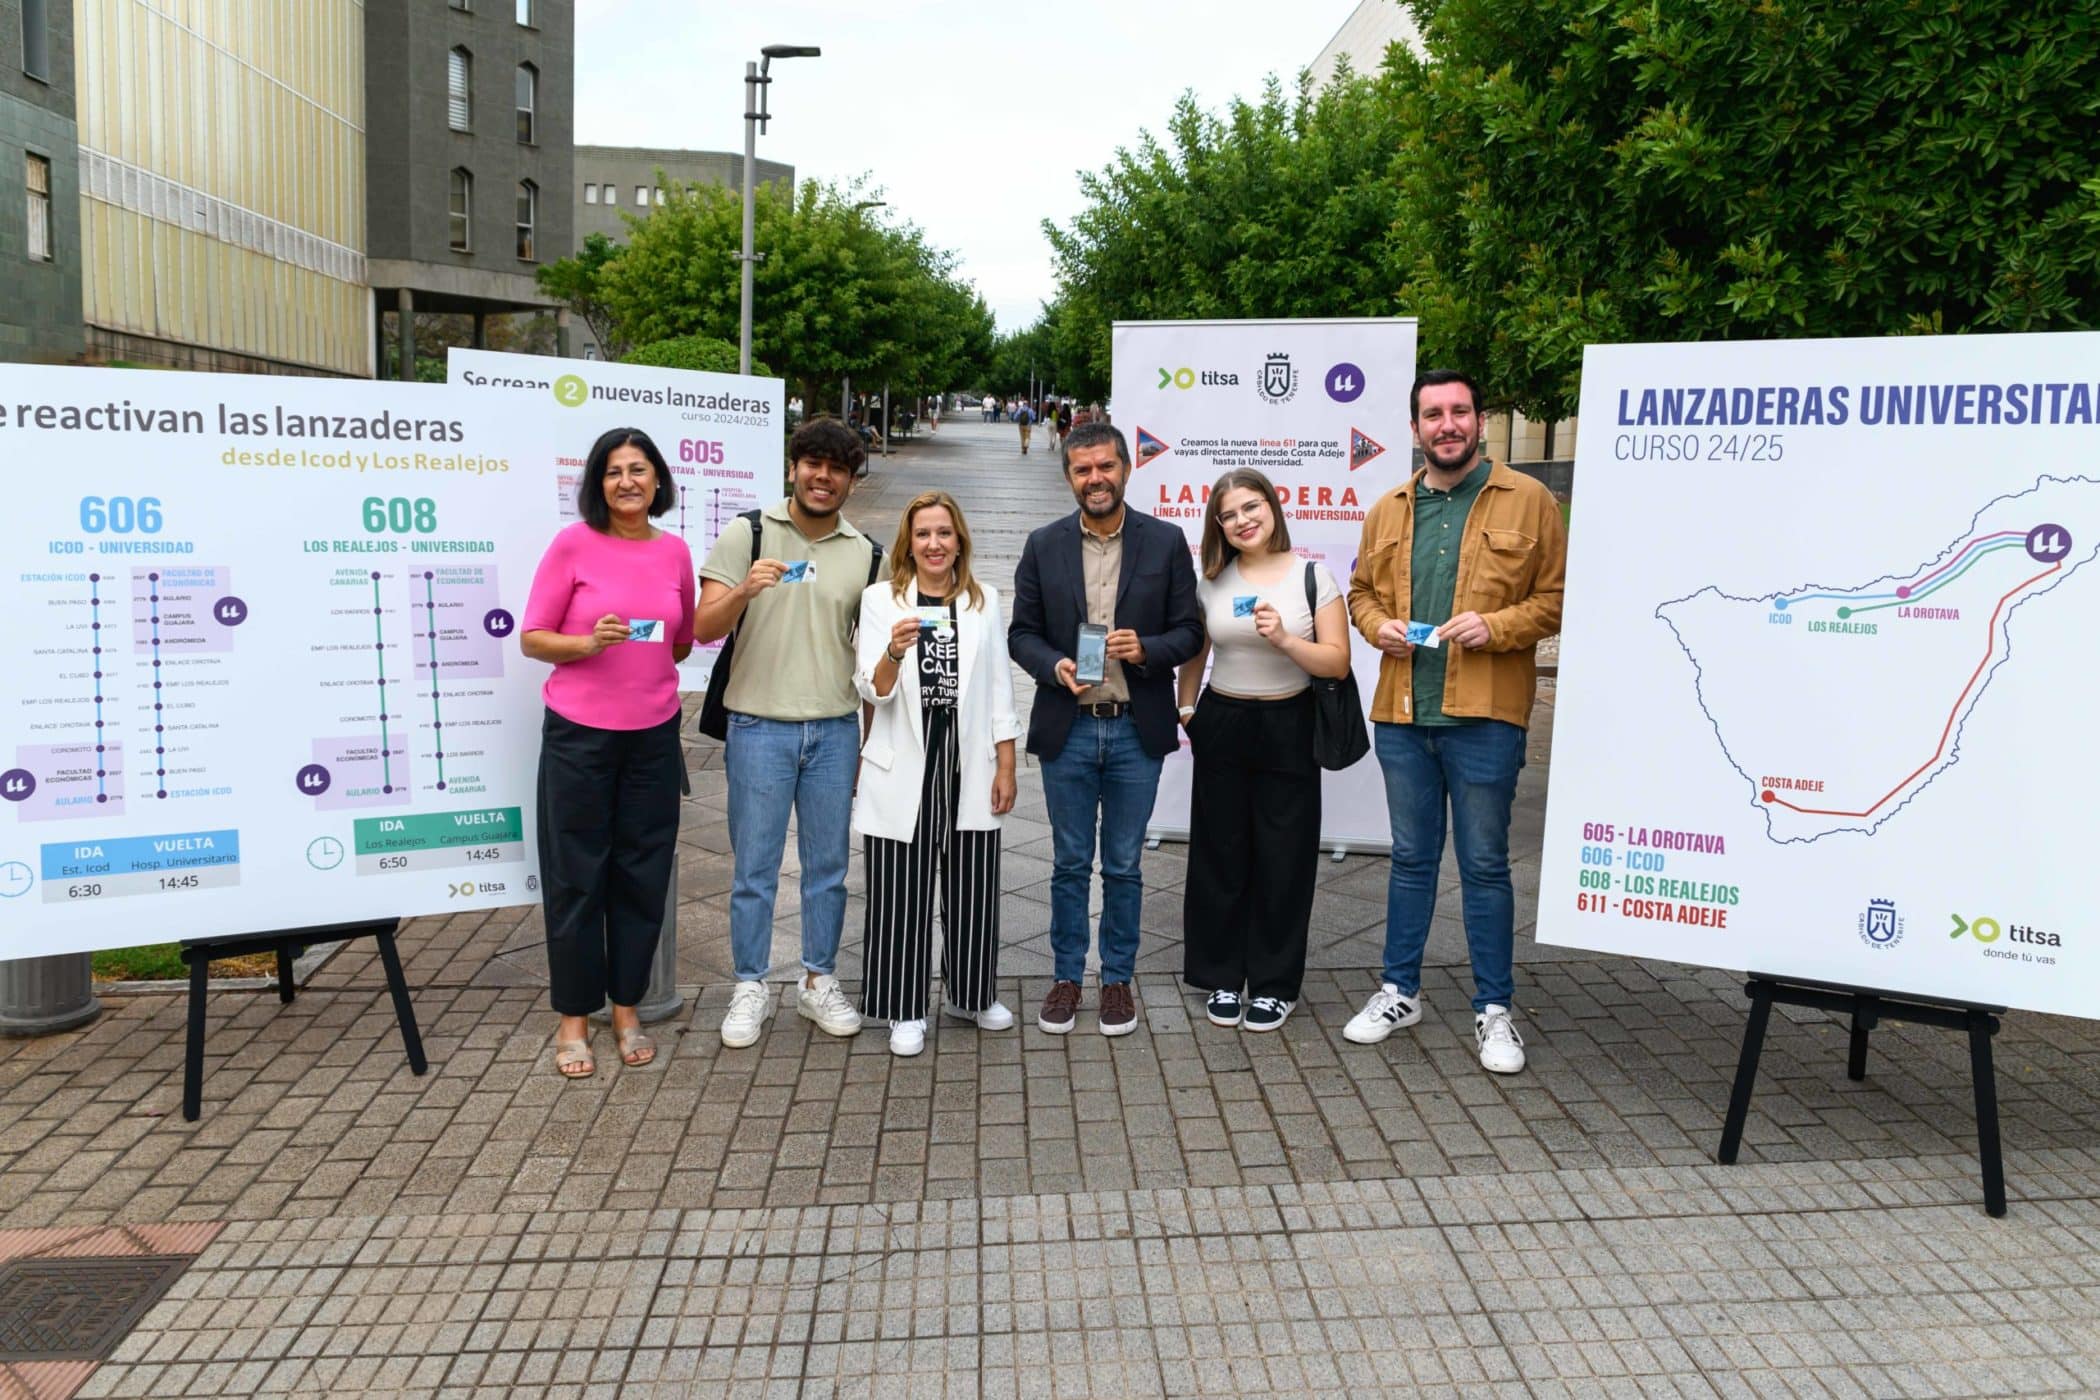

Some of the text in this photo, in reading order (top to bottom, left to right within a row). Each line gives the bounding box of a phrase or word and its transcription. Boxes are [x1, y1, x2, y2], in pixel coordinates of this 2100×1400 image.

[1201, 371, 1240, 386] titsa
[564, 382, 578, 401] 2
[592, 385, 663, 405] nuevas
[667, 386, 771, 414] lanzaderas
[1617, 383, 2100, 426] LANZADERAS UNIVERSITA
[17, 400, 204, 433] reactivan
[219, 404, 268, 436] las
[276, 406, 464, 442] lanzaderas
[681, 412, 769, 427] curso 2024/2025
[680, 439, 724, 465] 605
[1181, 438, 1218, 447] Creamos
[1220, 439, 1229, 447] la
[1283, 439, 1296, 447] 611
[1298, 440, 1319, 449] para
[1320, 440, 1339, 449] que
[1200, 448, 1259, 457] directamente
[1260, 449, 1289, 457] desde
[1290, 449, 1317, 457] Costa
[1318, 449, 1346, 458] Adeje
[1615, 434, 1784, 462] CURSO 24/25
[222, 447, 509, 475] desde Icod y Los Realejos
[1212, 457, 1304, 466] hasta la Universidad.
[671, 466, 696, 475] OTAVA
[703, 468, 754, 479] UNIVERSIDAD
[1160, 484, 1359, 507] LANDERA
[80, 496, 163, 534] 606
[362, 497, 437, 533] 608
[1153, 505, 1365, 521] LÍNEA 611 UNIVERSIDAD
[49, 541, 84, 554] ICOD
[99, 541, 194, 554] UNIVERSIDAD
[304, 541, 328, 553] LOS
[333, 541, 398, 553] REALEJOS
[411, 541, 495, 553] UNIVERSIDAD
[65, 573, 86, 582] ICOD
[335, 568, 368, 577] AVENIDA
[1768, 612, 1792, 625] ICOD
[1898, 607, 1960, 620] LA OROTAVA
[1808, 621, 1878, 635] LOS REALEJOS
[924, 641, 957, 659] KEE
[921, 657, 958, 677] CAL
[922, 686, 936, 696] RY
[938, 677, 957, 688] AND
[212, 787, 232, 796] ICOD
[1762, 776, 1825, 793] COSTA ADEJE
[379, 812, 506, 832] IDA VUELTA
[366, 829, 518, 849] Los Realejos Campus Guajara
[1583, 822, 1615, 843] 605
[1628, 826, 1648, 846] LA
[1652, 829, 1726, 855] OROTAVA
[74, 837, 215, 860] IDA VUELTA
[62, 865, 83, 875] Est.
[86, 862, 110, 873] Icod
[166, 853, 237, 867] Universitario
[379, 848, 500, 870] 6:50 14:45
[1581, 846, 1613, 866] 606
[1626, 850, 1665, 872] ICOD
[68, 875, 199, 898] 6:30 14:45
[479, 882, 506, 893] titsa
[1579, 869, 1611, 890] 608
[1624, 874, 1655, 896] LOS
[1658, 878, 1740, 905] REALEJOS
[1577, 892, 1607, 913] 611
[1622, 898, 1673, 922] COSTA
[1677, 905, 1728, 928] ADEJE
[2009, 924, 2062, 947] titsa
[1983, 948, 2056, 965] donde tú vas
